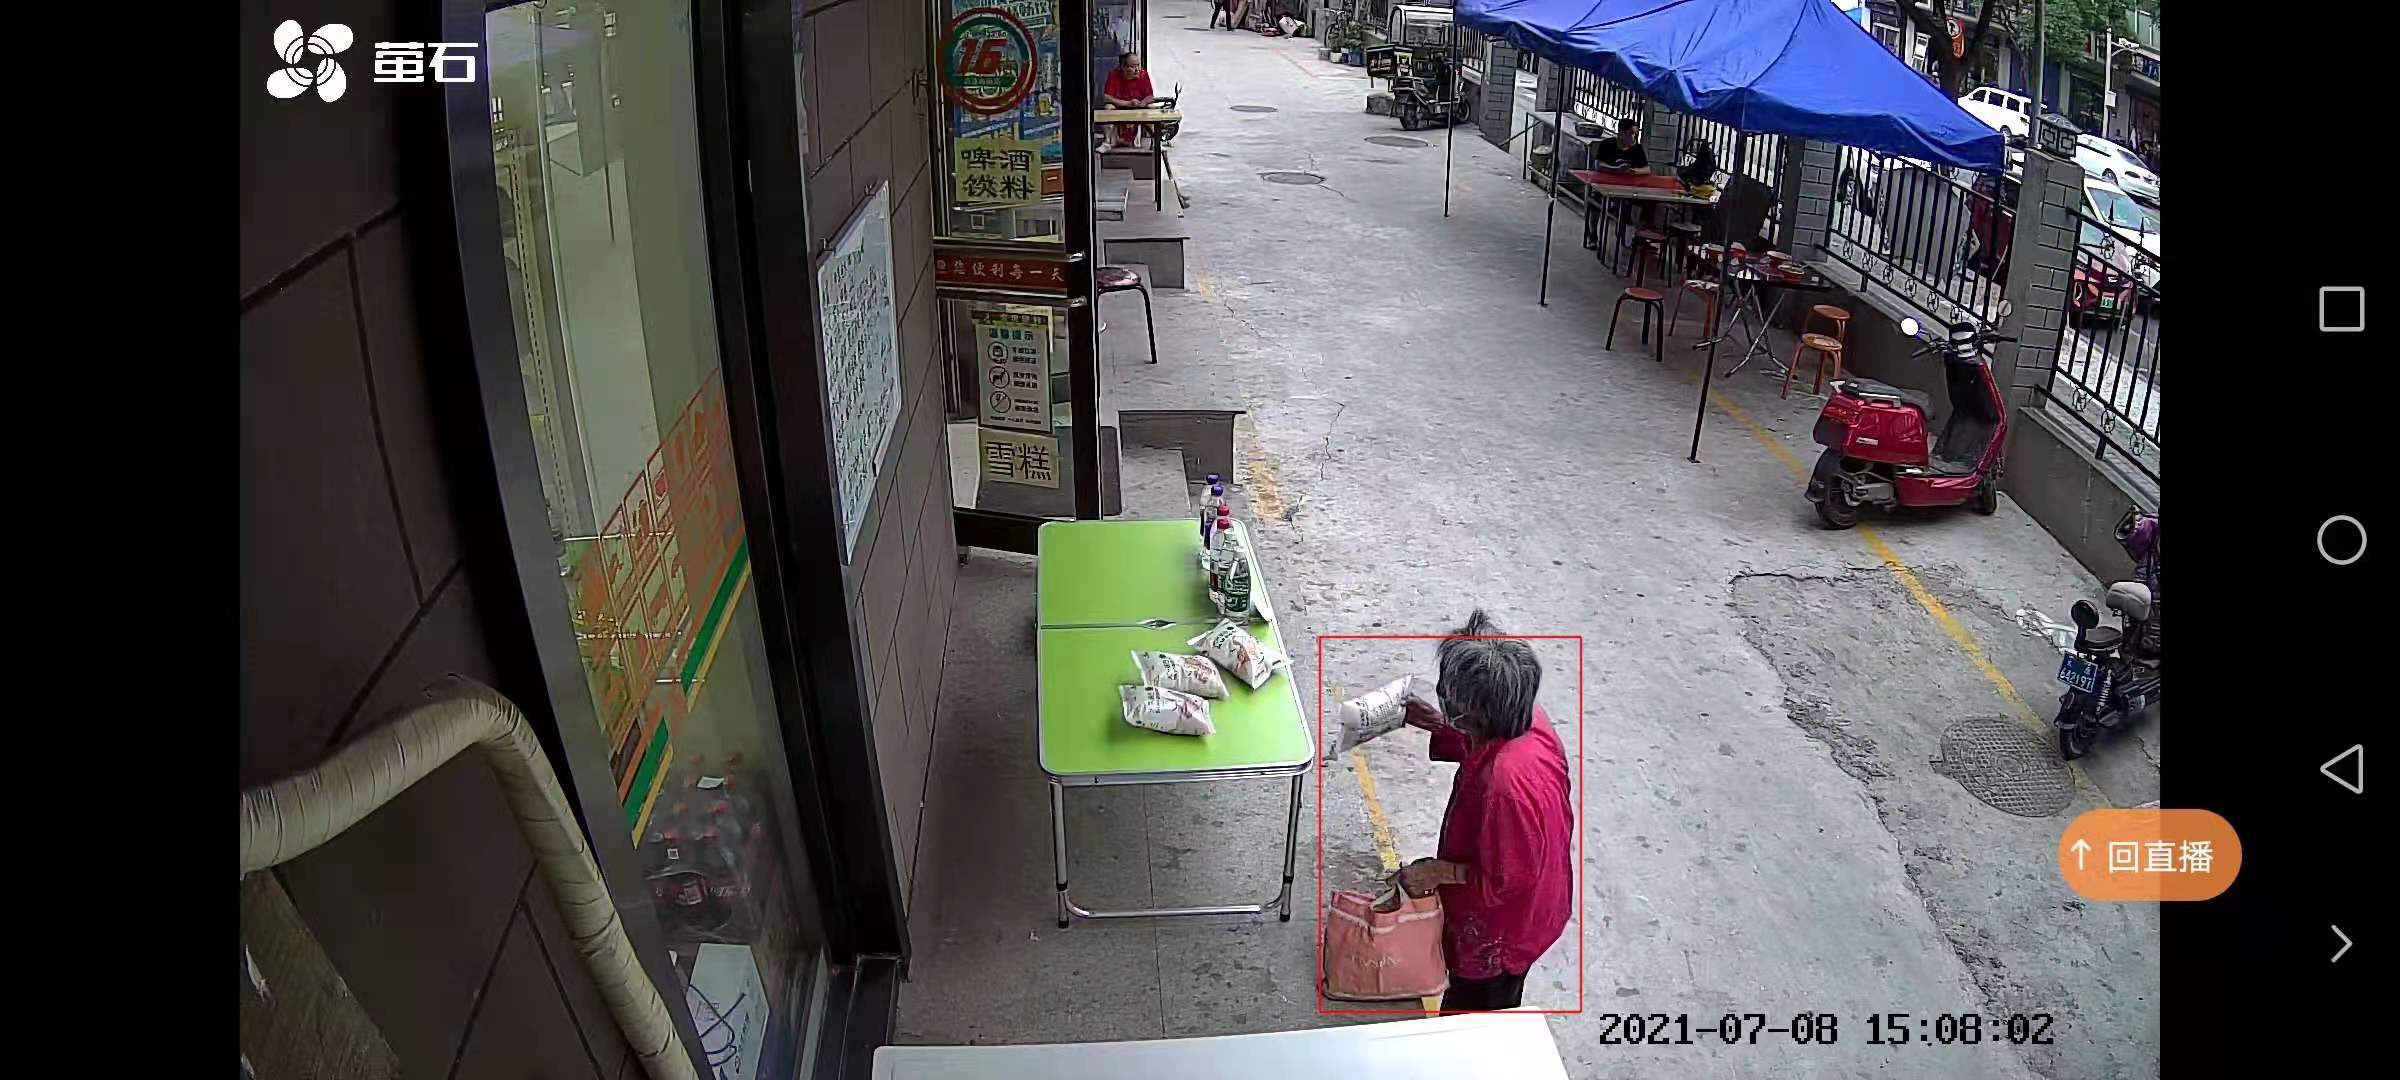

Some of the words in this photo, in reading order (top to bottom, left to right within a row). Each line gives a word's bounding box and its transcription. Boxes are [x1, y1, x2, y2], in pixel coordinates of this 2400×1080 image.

[961, 147, 1033, 172] 啤酒
[962, 174, 1035, 200] 饮料
[985, 441, 1052, 481] 雪糕
